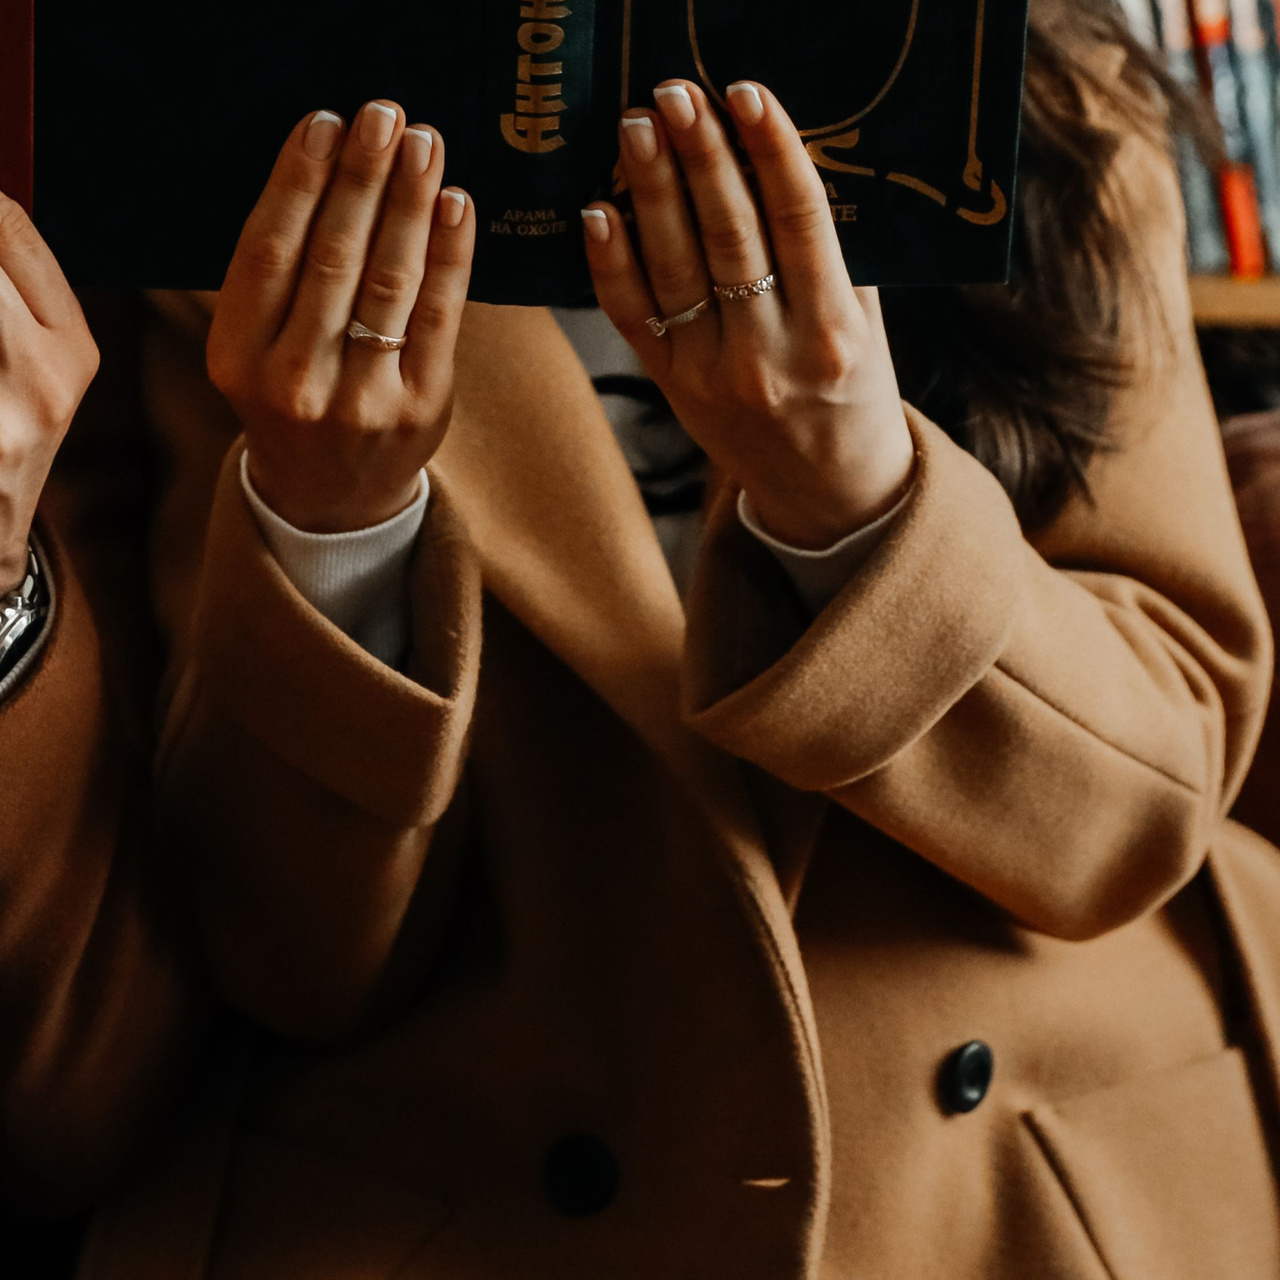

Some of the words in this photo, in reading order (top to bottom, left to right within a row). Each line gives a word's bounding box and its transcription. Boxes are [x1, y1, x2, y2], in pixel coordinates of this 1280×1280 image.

[503, 208, 557, 222] ДРАМА
[490, 220, 513, 235] НА
[517, 220, 568, 236] ОХОТЕ
